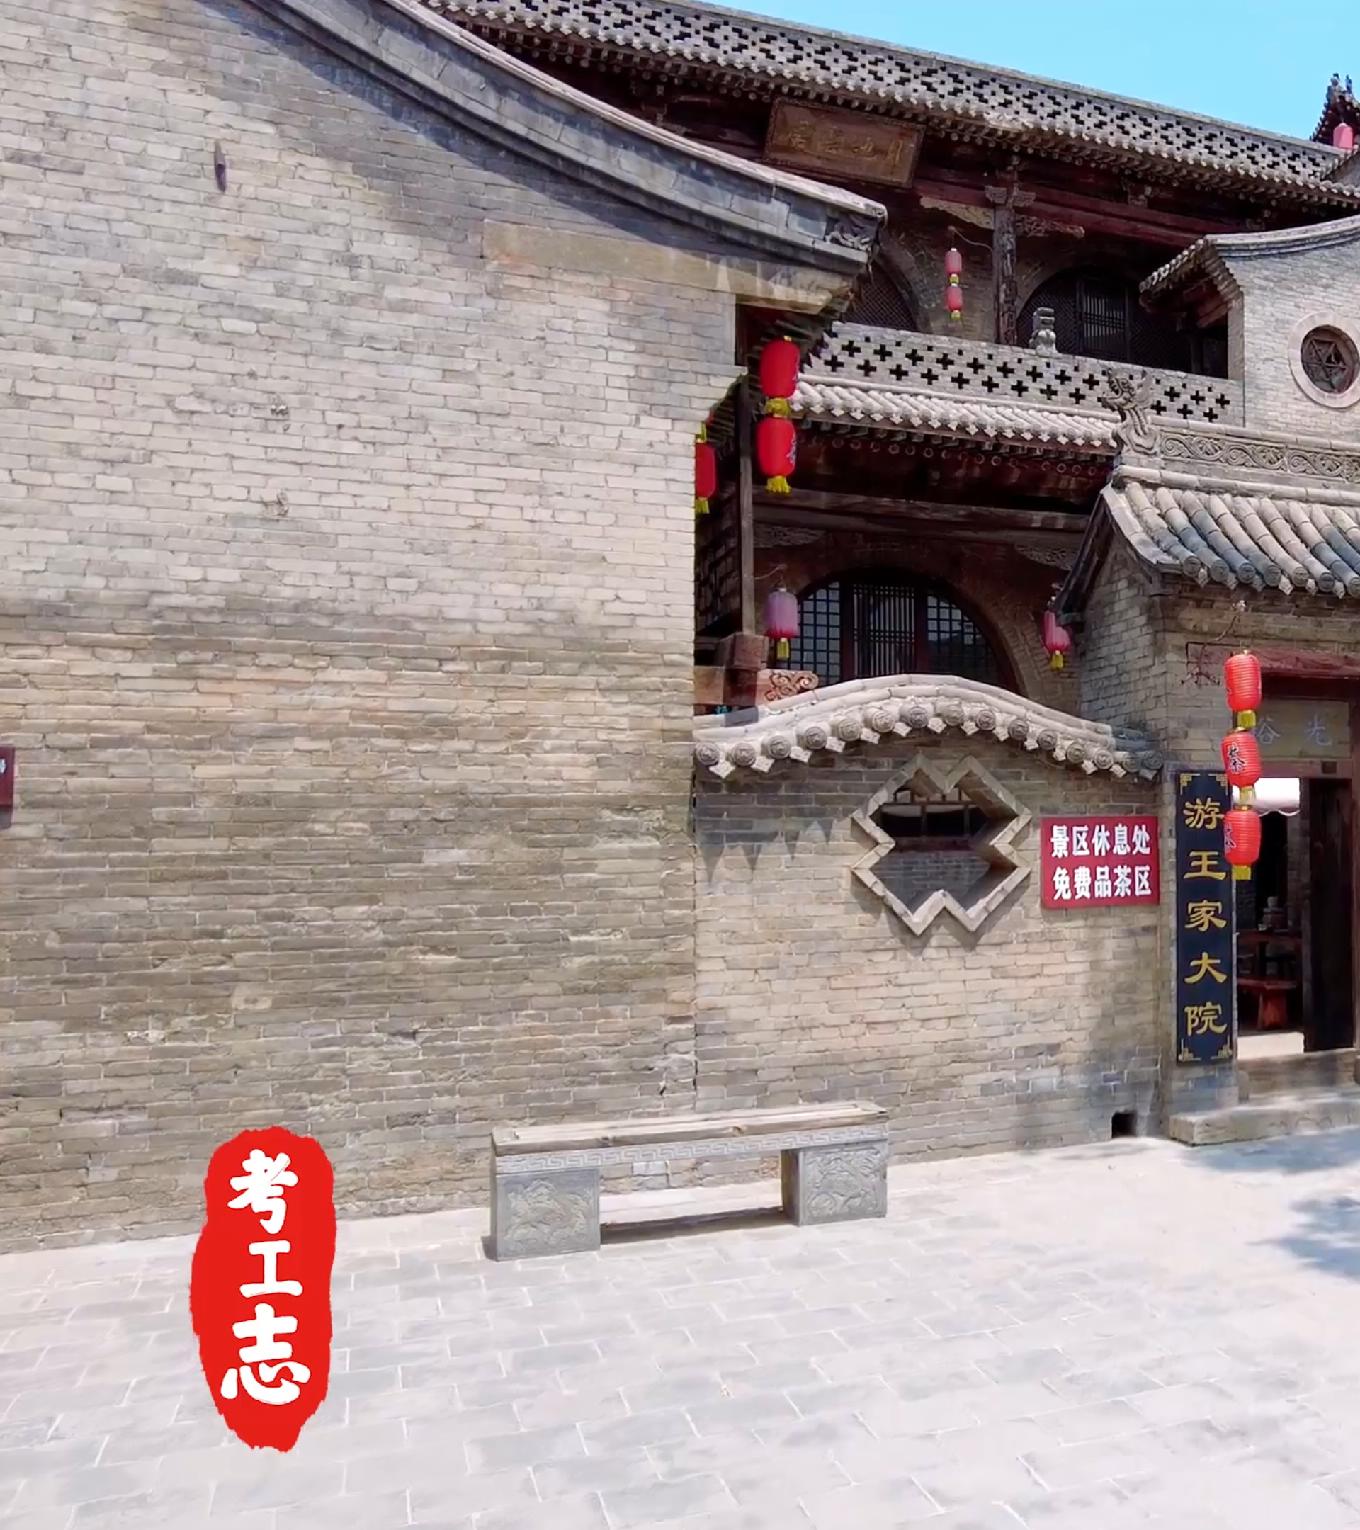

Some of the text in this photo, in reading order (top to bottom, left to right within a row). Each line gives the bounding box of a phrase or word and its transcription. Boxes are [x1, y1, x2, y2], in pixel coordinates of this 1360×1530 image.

[1050, 824, 1151, 857] 景区休息处
[1053, 865, 1152, 900] 免费品茶区
[1183, 798, 1227, 1036] 游王家大院
